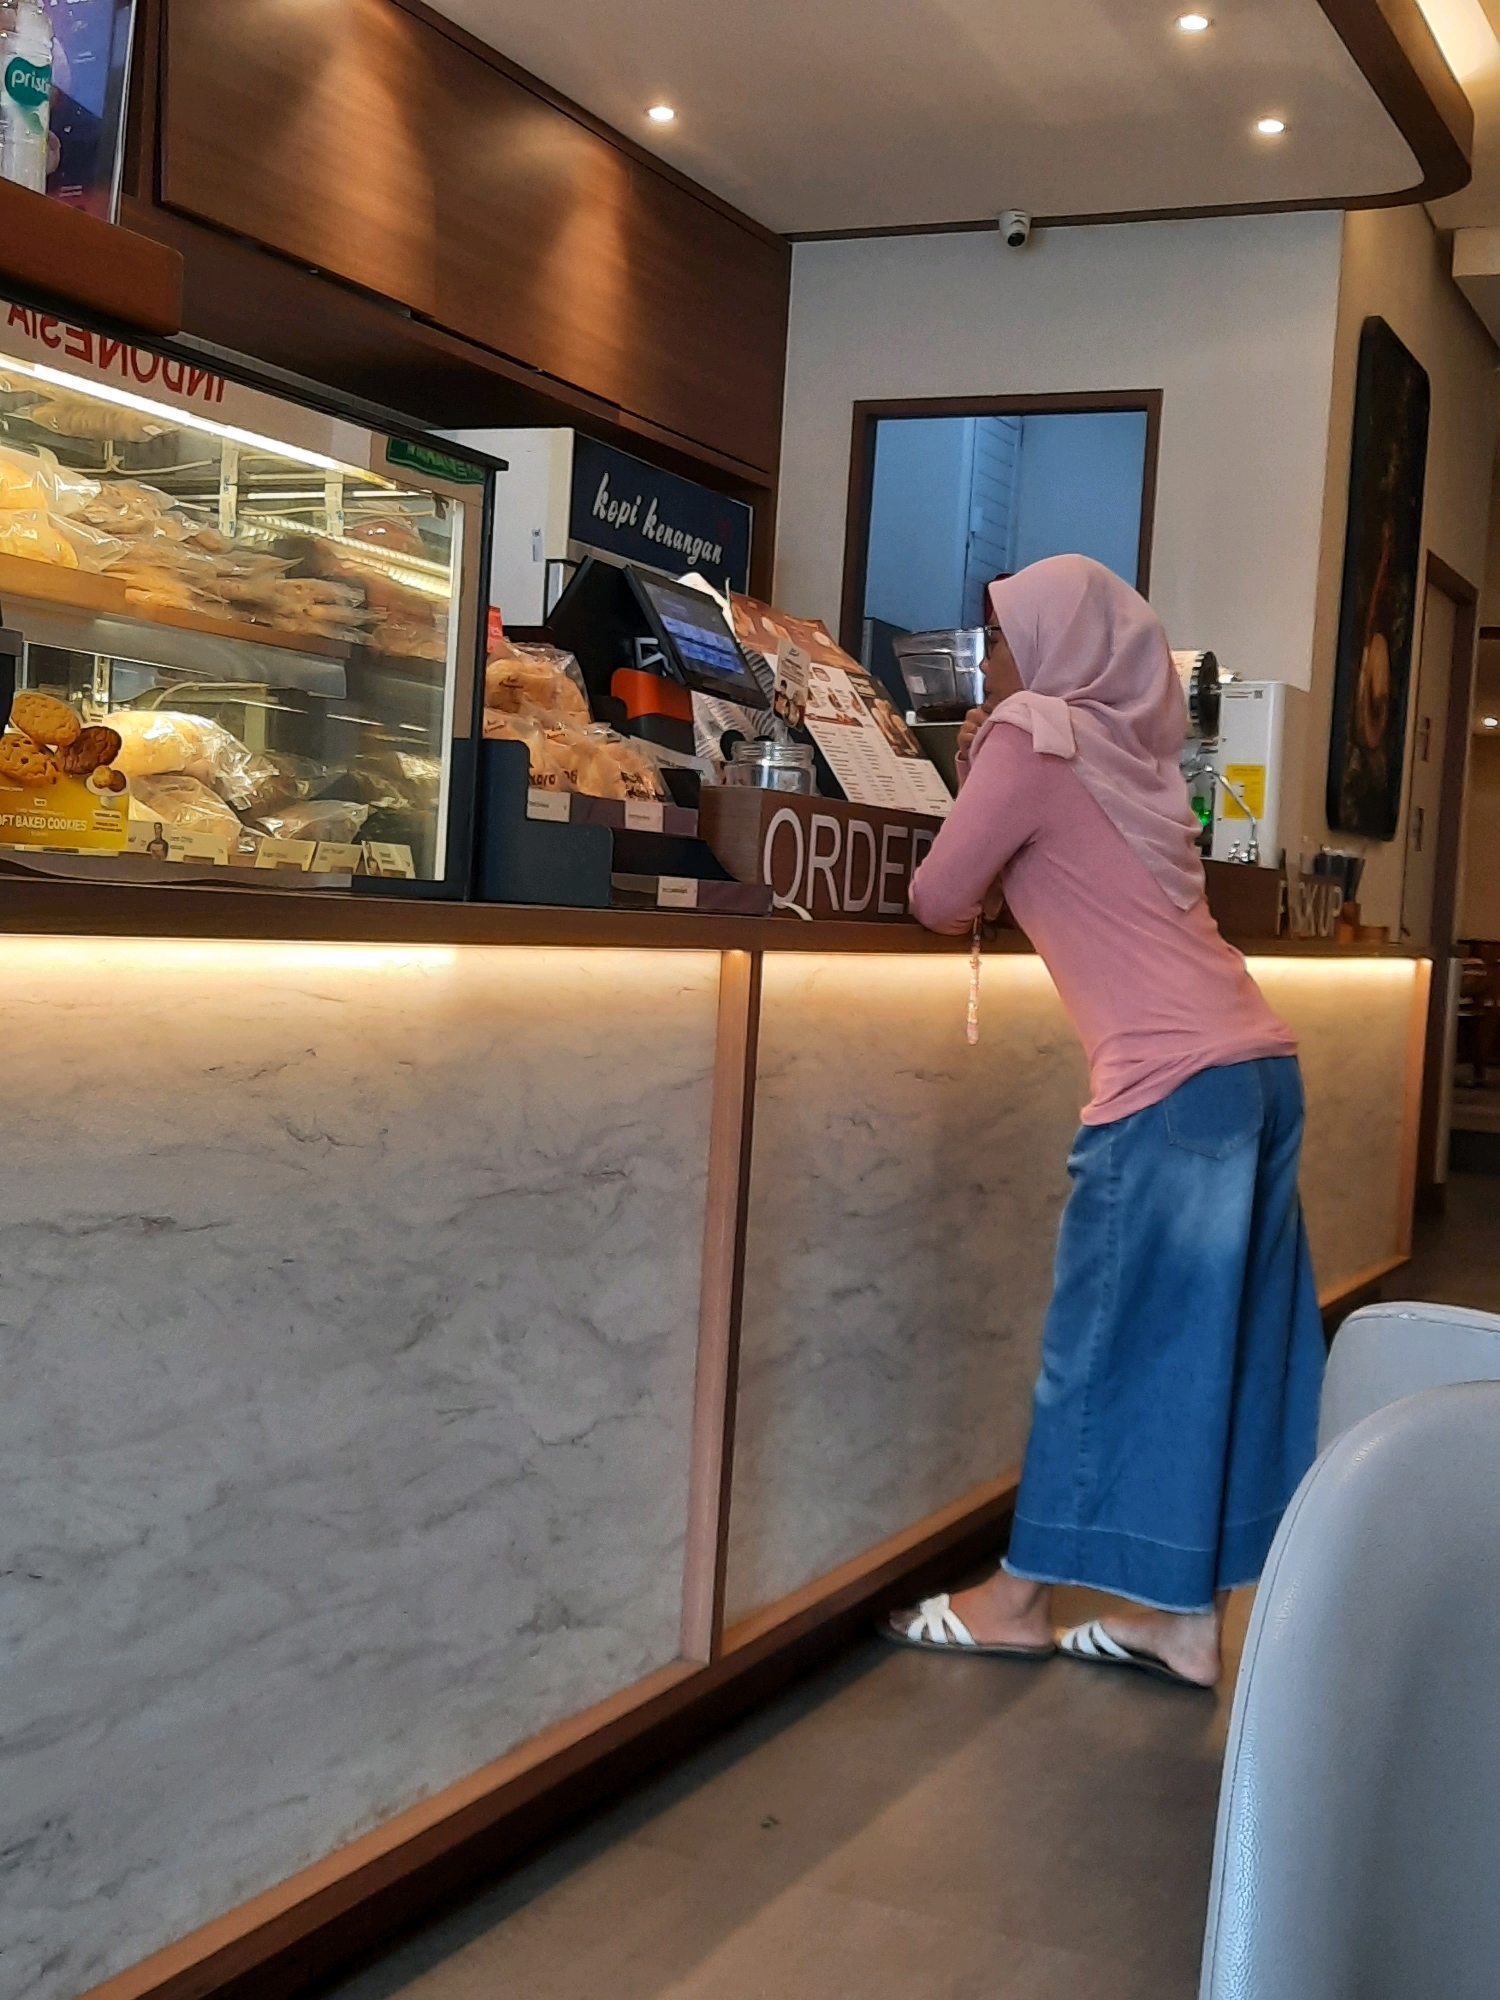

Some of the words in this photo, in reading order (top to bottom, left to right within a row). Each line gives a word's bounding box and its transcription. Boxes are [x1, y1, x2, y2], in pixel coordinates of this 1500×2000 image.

[592, 471, 642, 529] kopi
[642, 497, 723, 565] kenangan
[16, 815, 46, 829] BAKED
[47, 816, 88, 832] COOKIES
